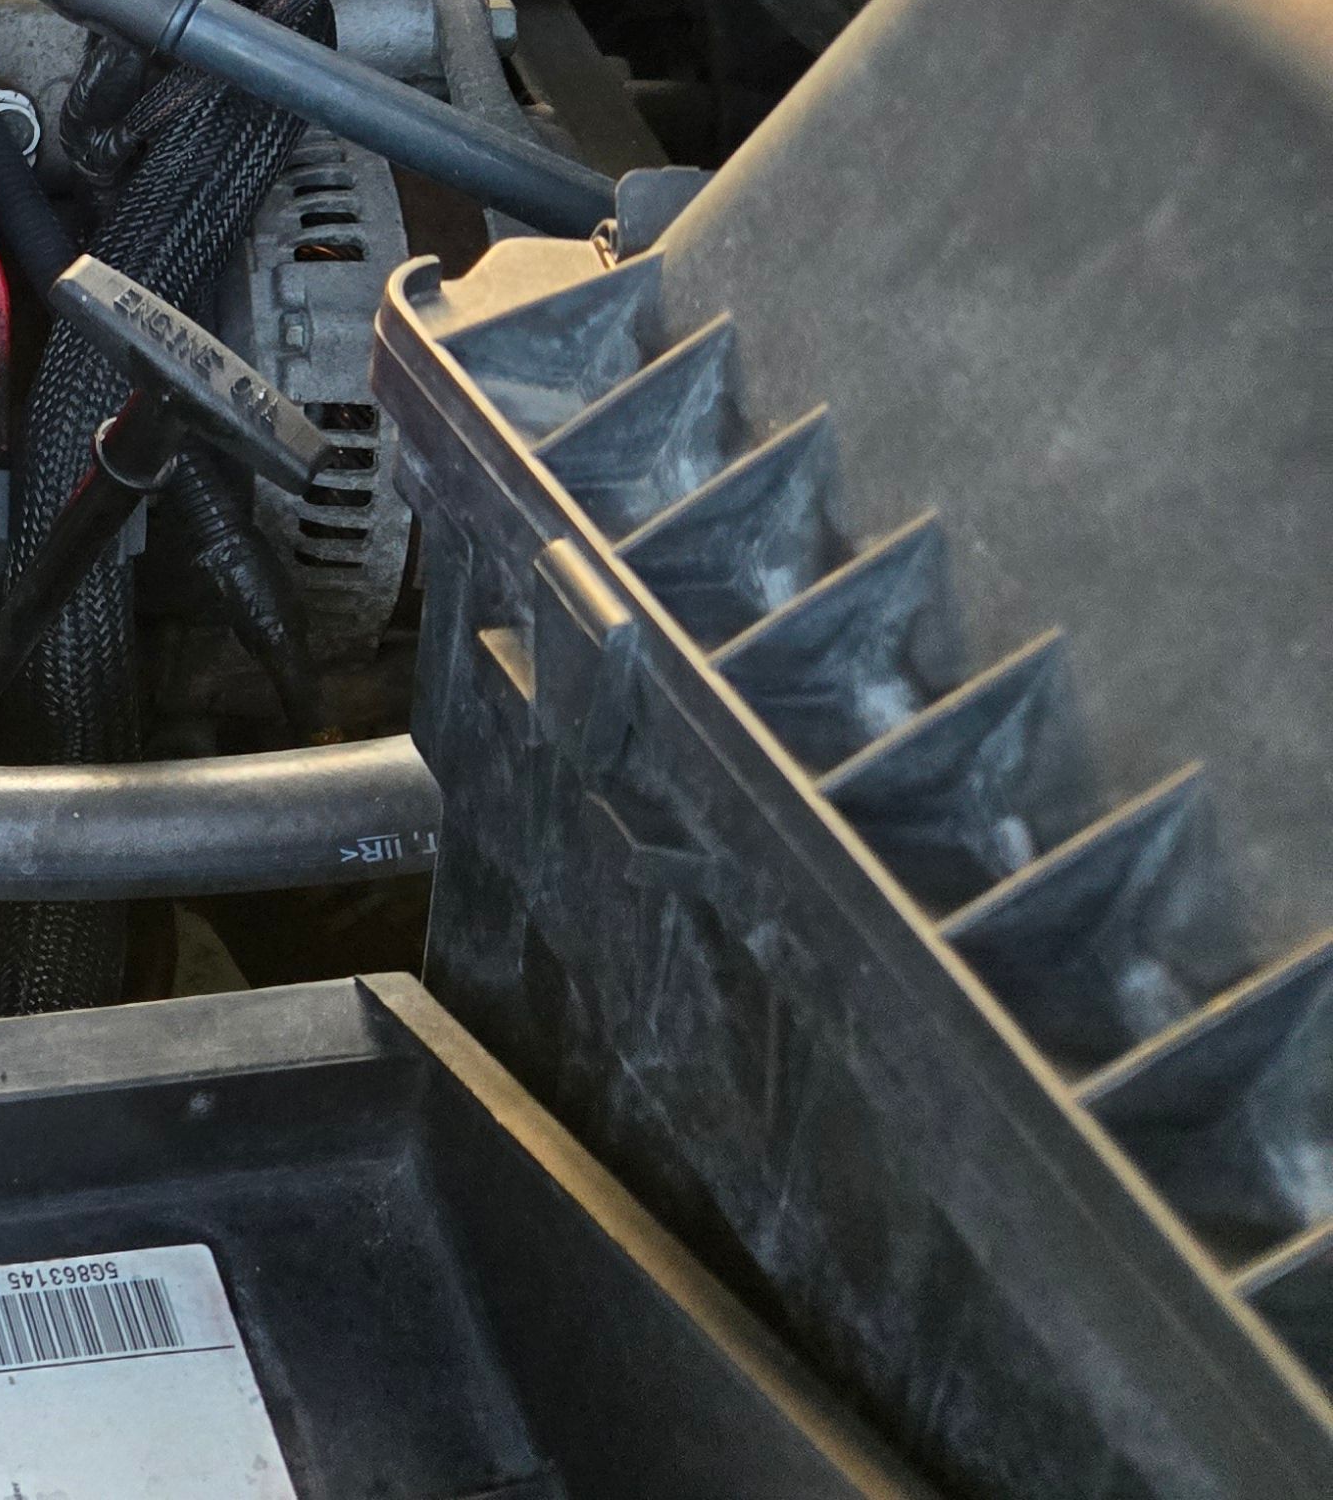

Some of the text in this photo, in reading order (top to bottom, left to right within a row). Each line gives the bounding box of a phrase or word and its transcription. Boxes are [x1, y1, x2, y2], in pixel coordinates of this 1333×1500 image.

[113, 285, 278, 422] ENGINE OIL
[7, 1261, 119, 1290] 5G863145
